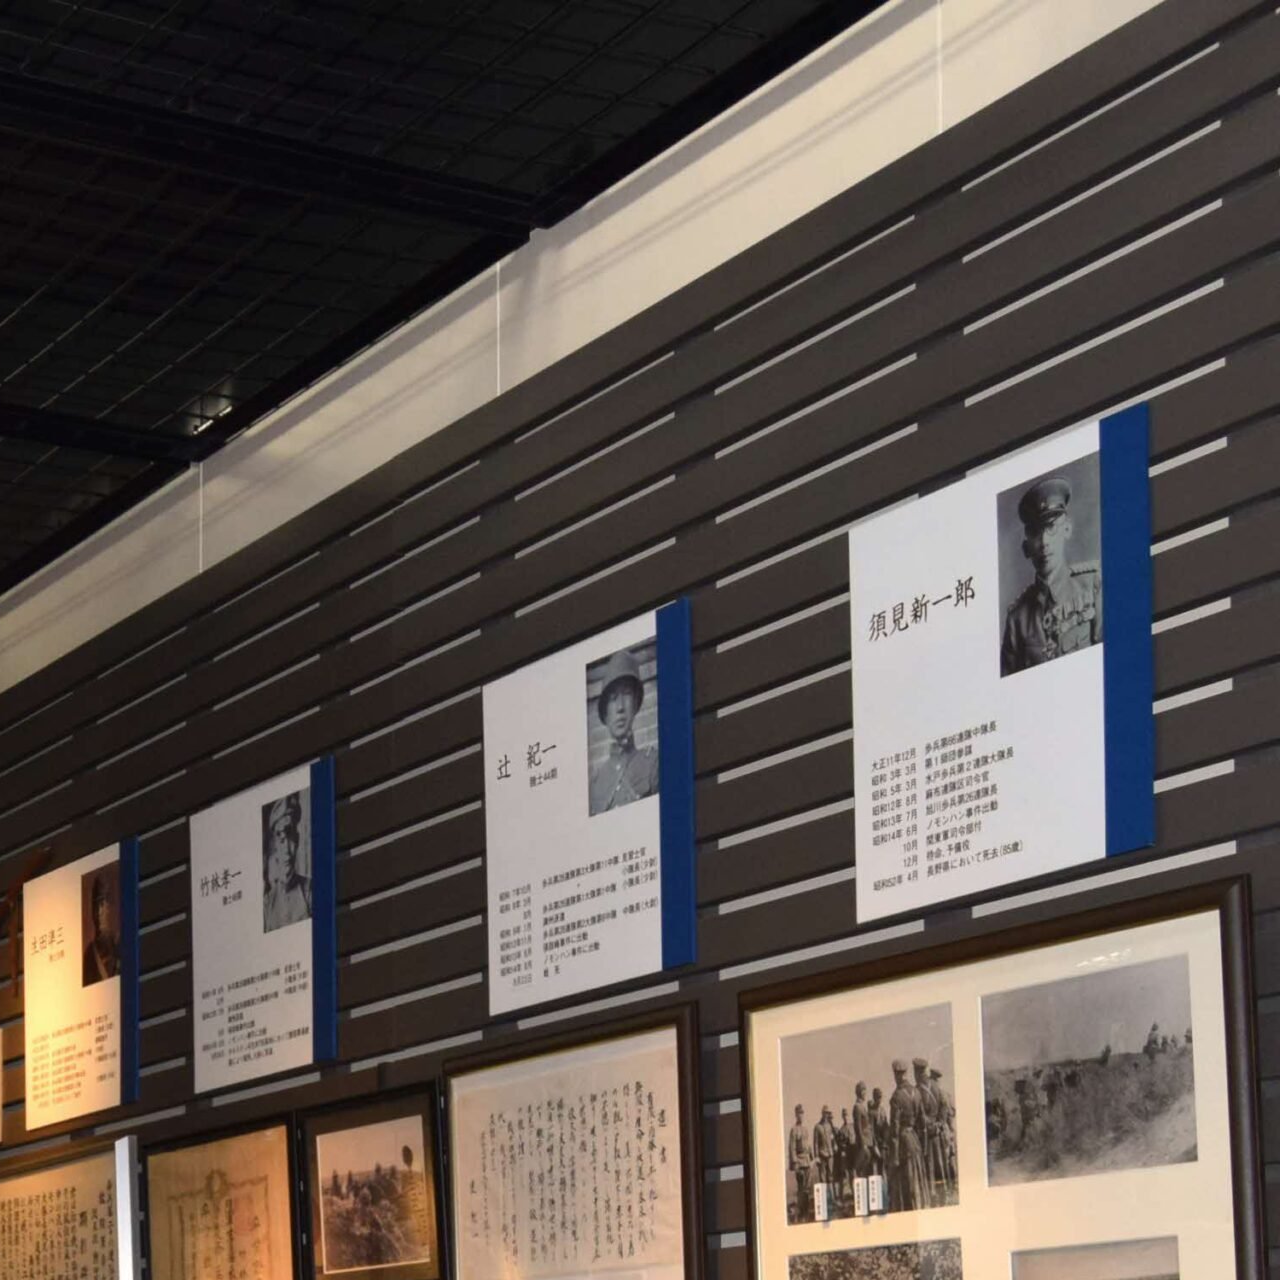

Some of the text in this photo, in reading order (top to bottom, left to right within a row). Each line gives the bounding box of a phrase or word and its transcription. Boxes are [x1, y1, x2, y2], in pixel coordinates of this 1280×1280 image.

[869, 576, 975, 641] 須見新一郎
